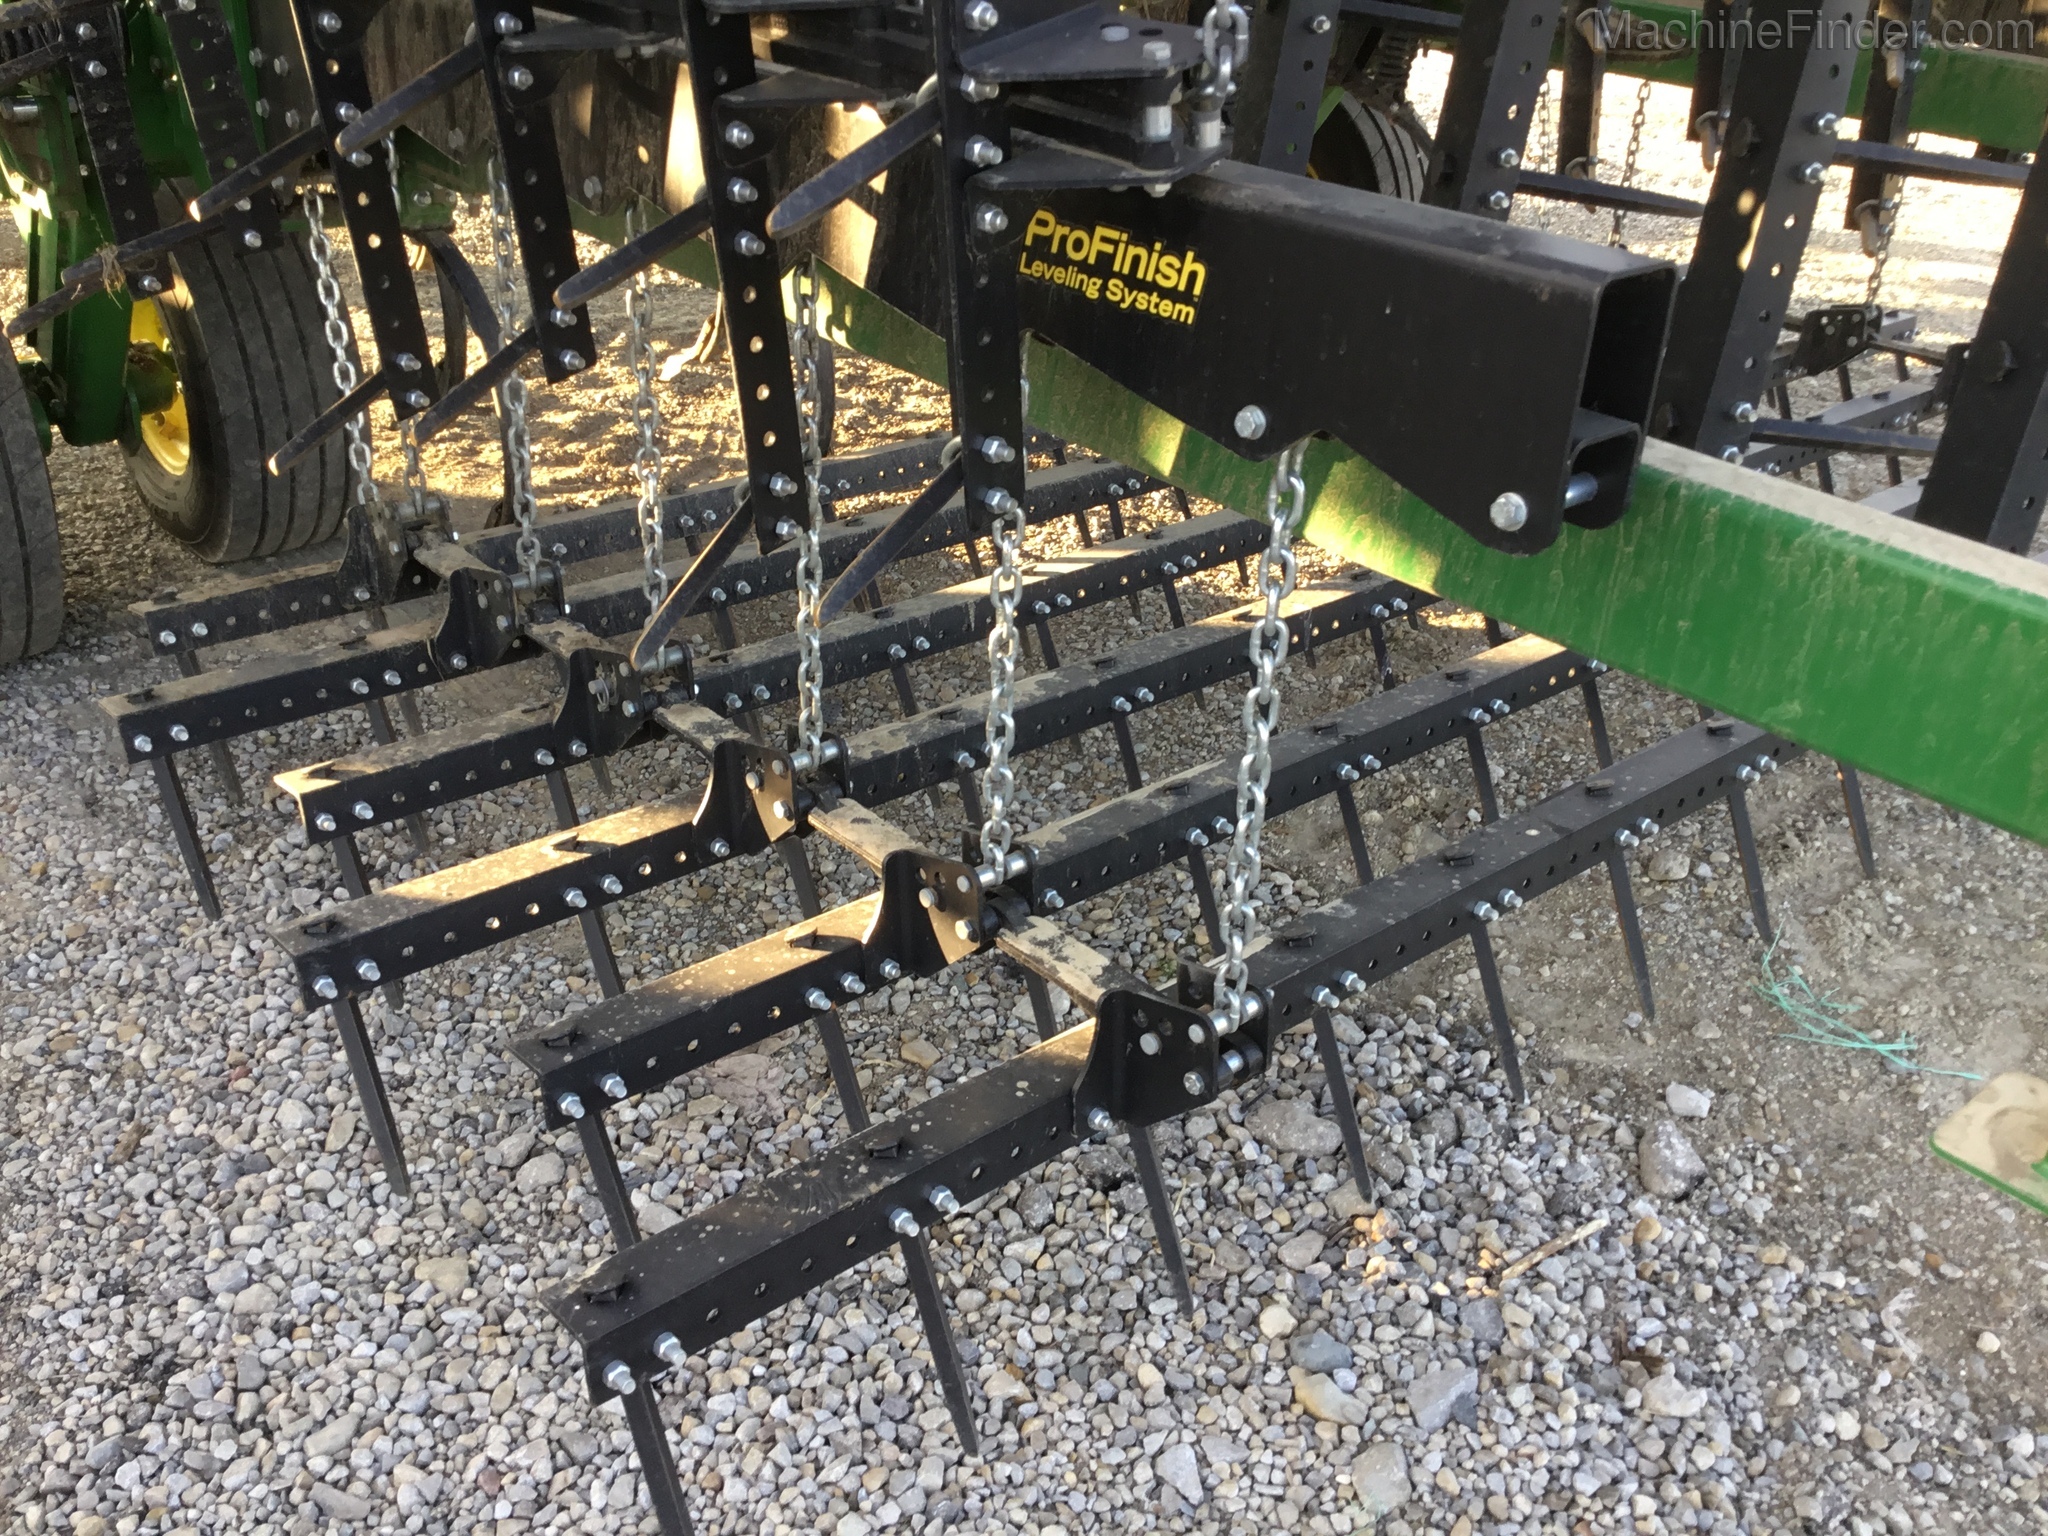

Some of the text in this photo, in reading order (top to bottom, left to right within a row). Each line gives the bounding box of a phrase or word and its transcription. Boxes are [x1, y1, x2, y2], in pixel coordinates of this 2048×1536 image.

[1019, 251, 1195, 325] Leveling System
[1024, 208, 1206, 296] ProFinish
